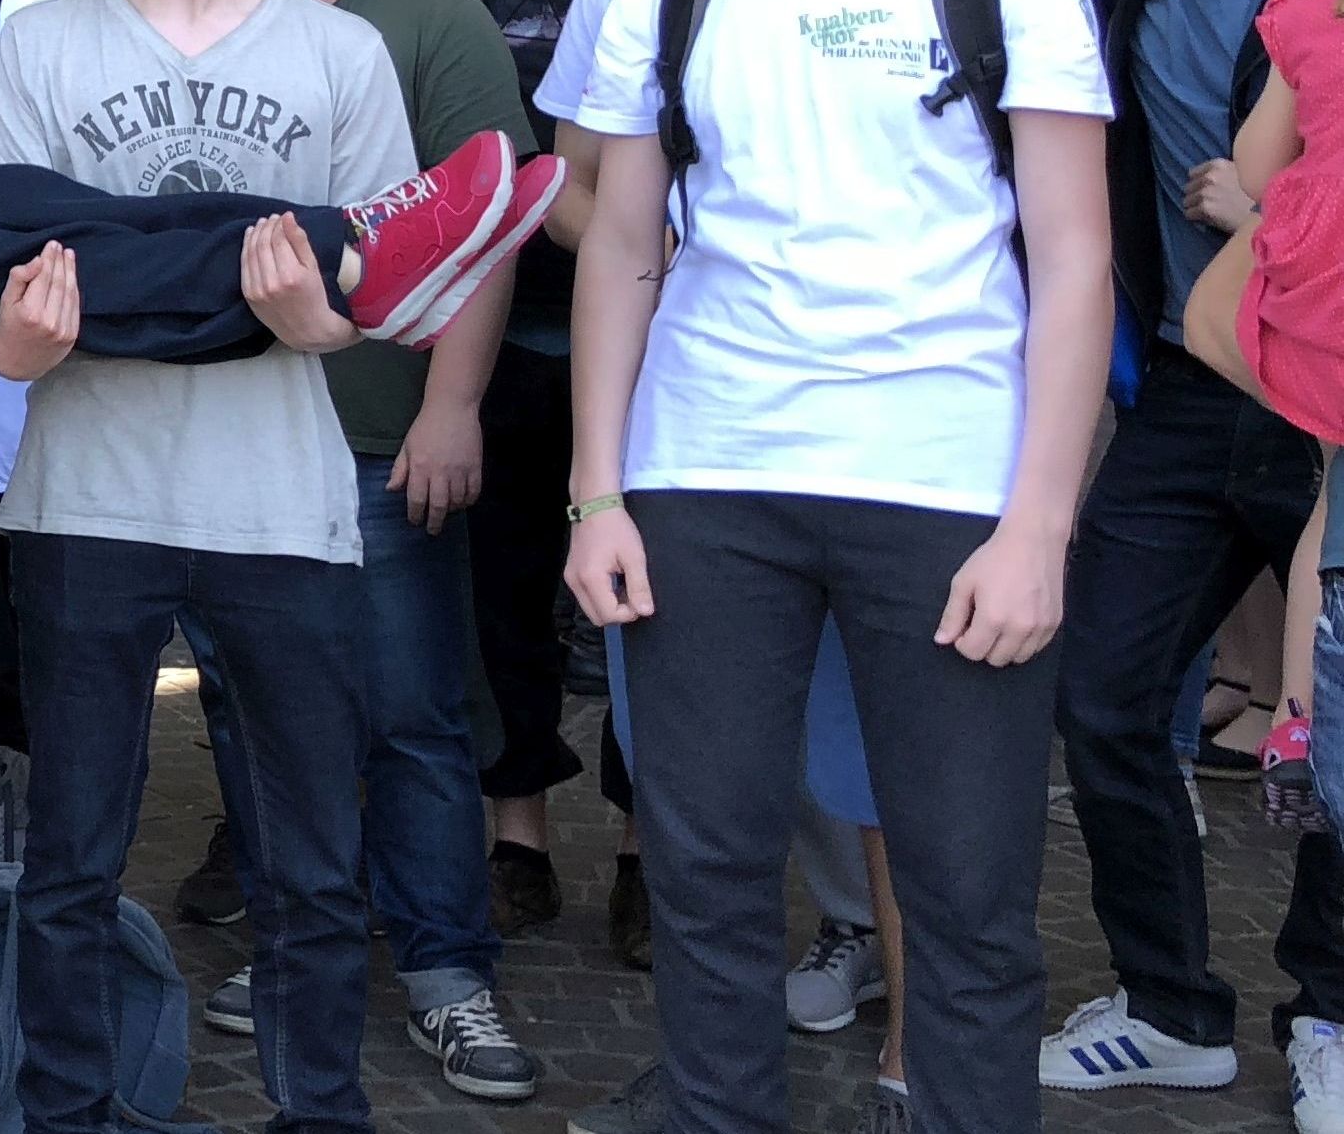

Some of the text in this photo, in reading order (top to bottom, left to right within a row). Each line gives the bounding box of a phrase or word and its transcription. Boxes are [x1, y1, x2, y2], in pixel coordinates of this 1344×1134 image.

[72, 78, 312, 163] NEW YORK
[125, 131, 163, 155] SPECIAL
[200, 127, 247, 147] TRAINING
[137, 138, 249, 194] COLLEGE LEAGUE
